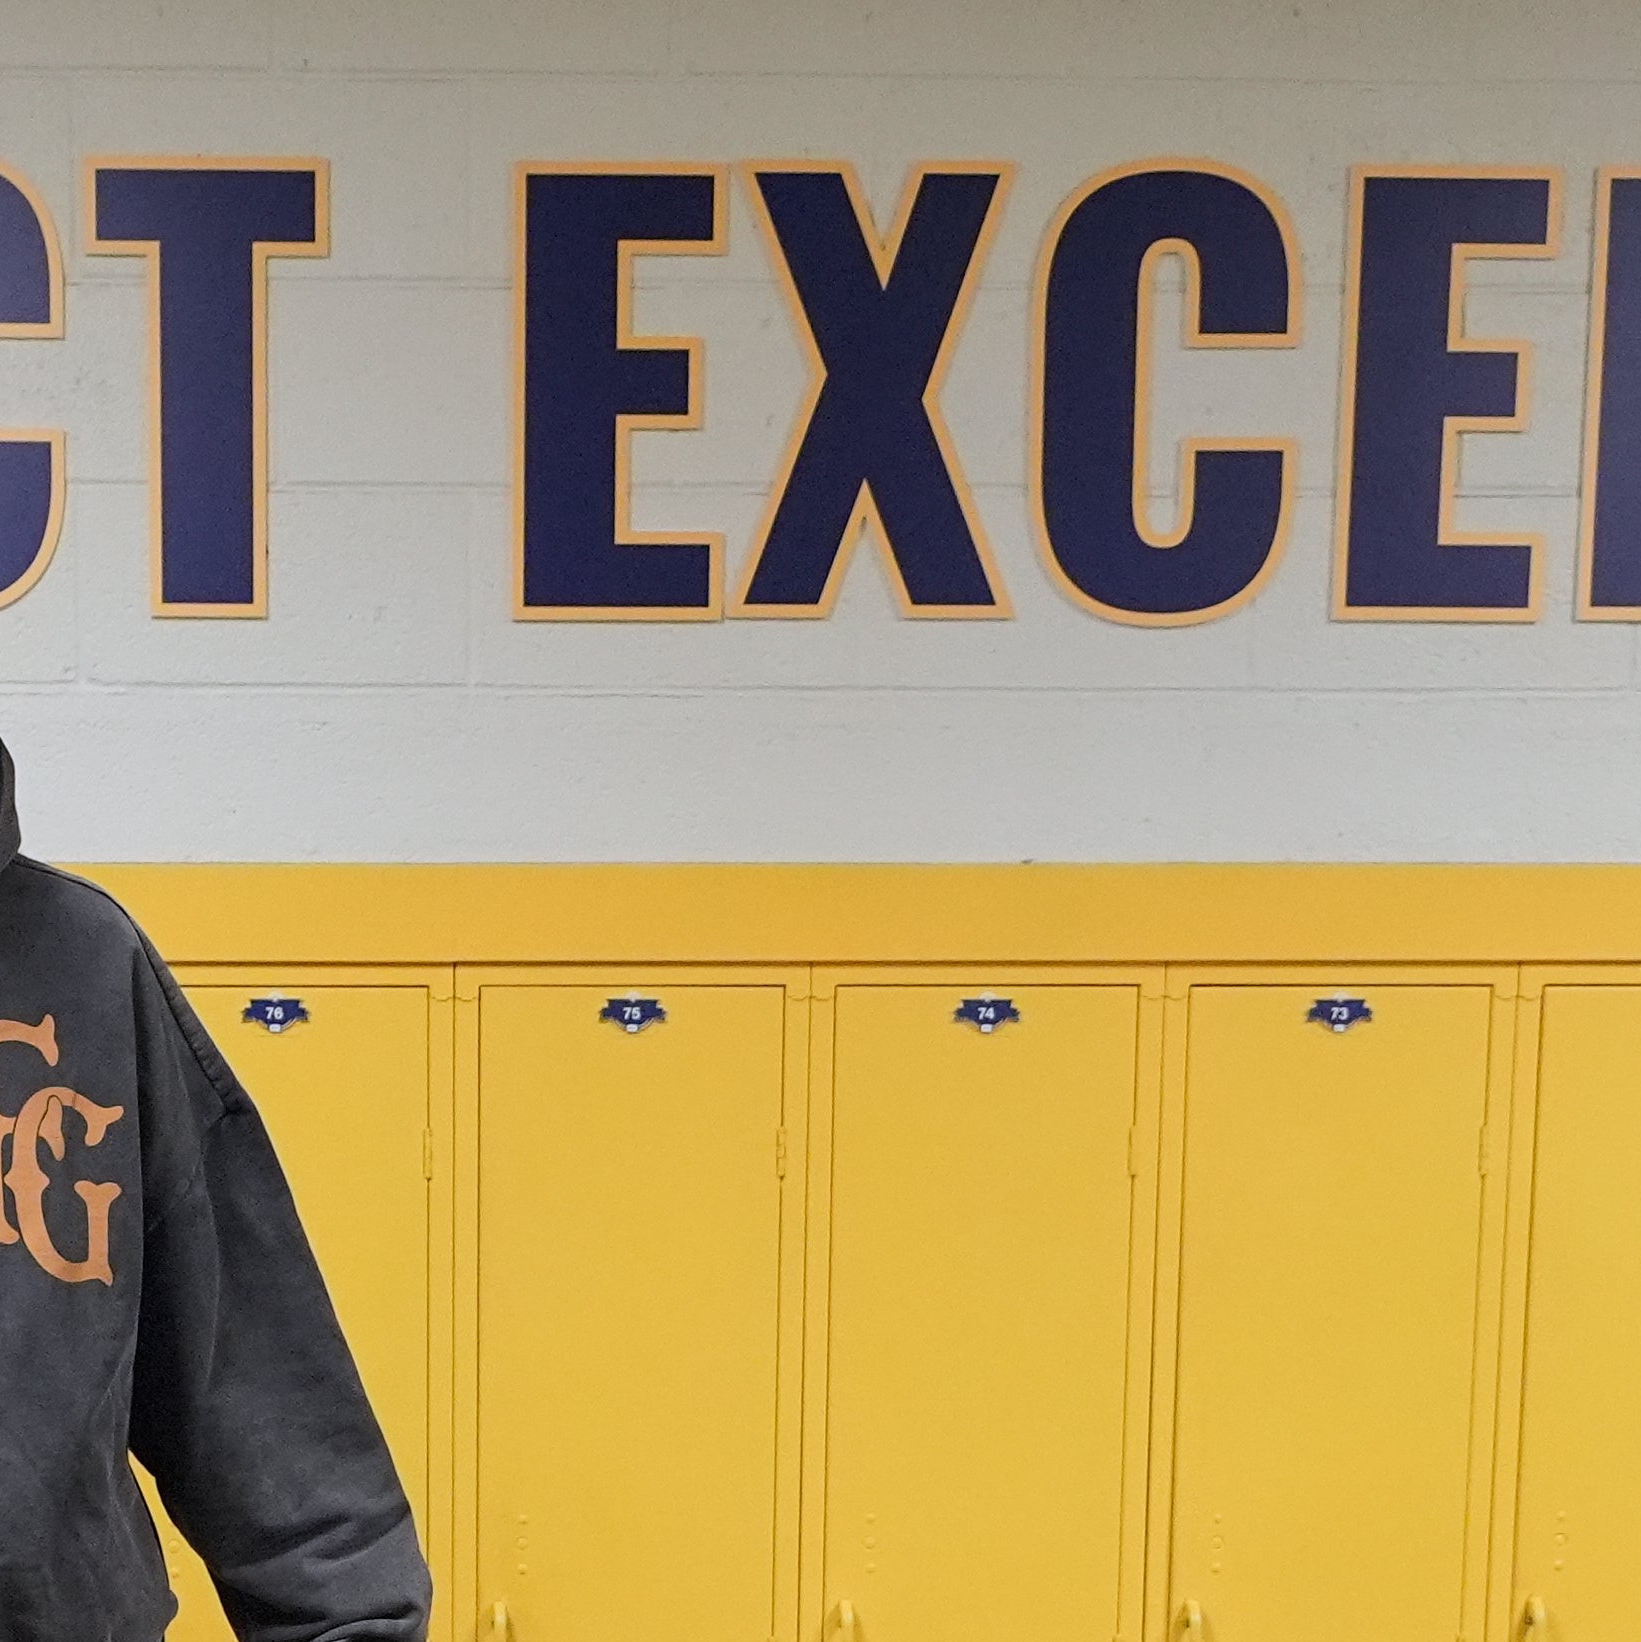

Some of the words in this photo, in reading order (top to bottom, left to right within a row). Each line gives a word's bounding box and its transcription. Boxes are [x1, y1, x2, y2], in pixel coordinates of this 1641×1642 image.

[265, 1006, 284, 1020] 76
[622, 1006, 642, 1020] 75
[977, 1006, 995, 1020] 74
[1330, 1006, 1349, 1020] 73
